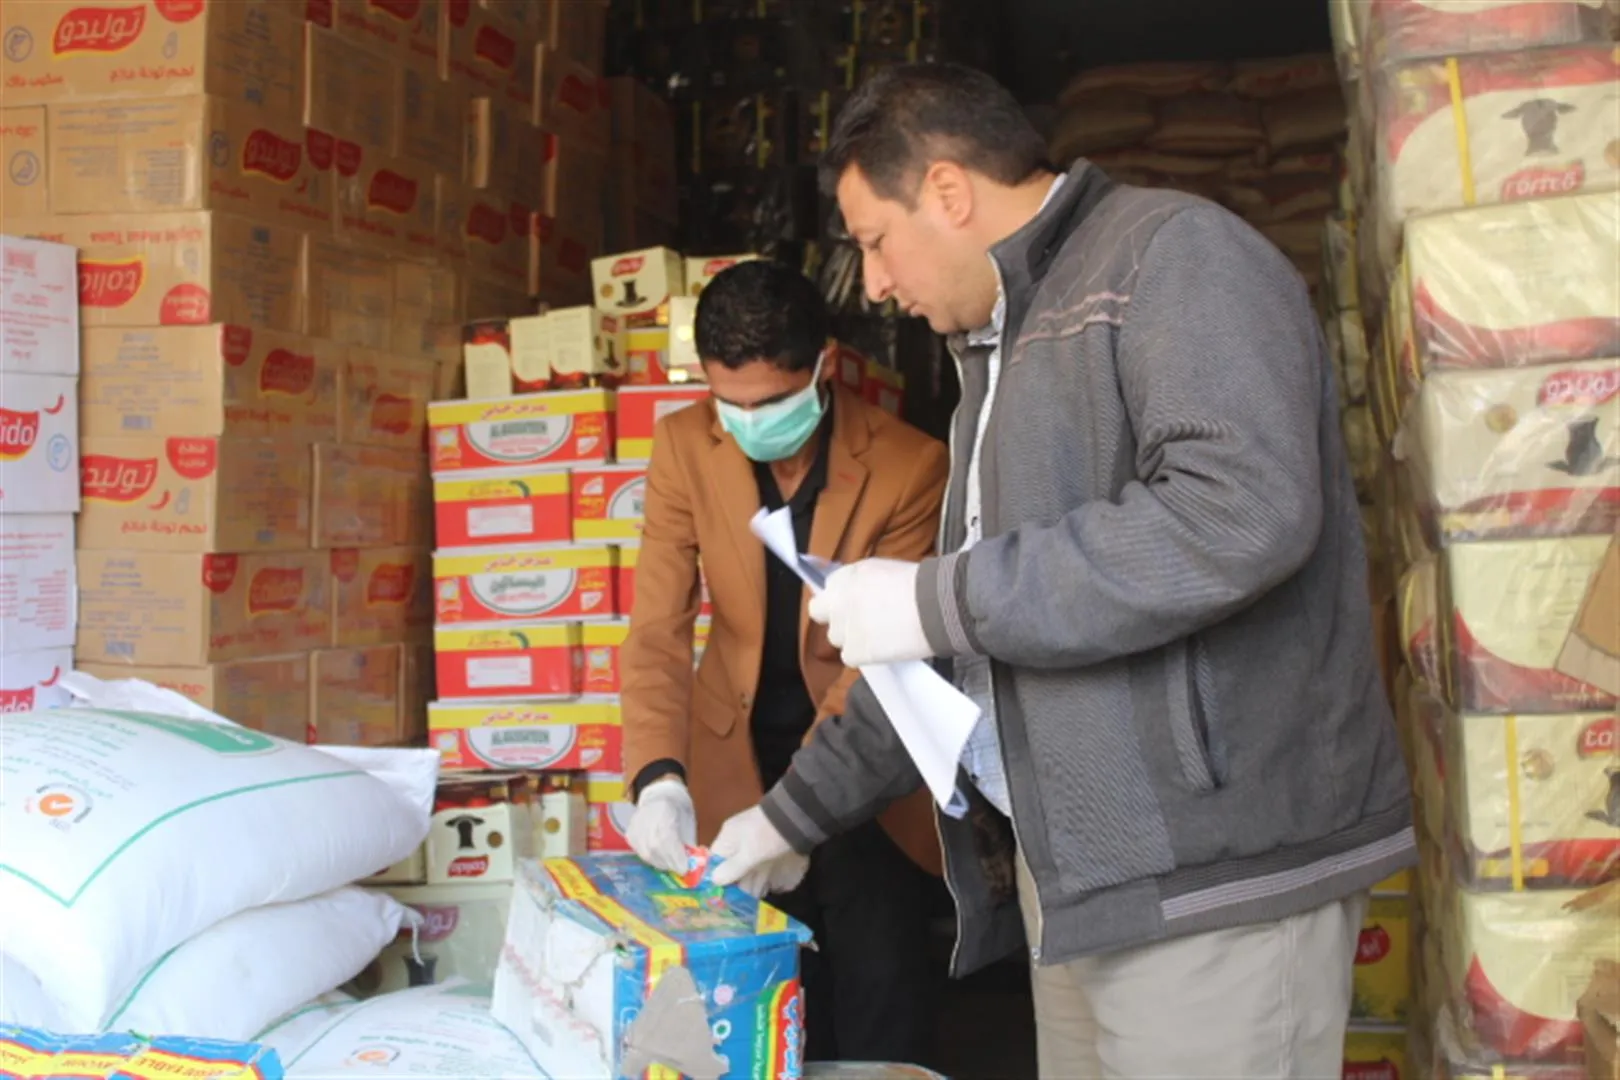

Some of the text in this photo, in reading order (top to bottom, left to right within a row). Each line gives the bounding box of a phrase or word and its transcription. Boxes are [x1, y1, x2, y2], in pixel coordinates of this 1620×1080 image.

[59, 11, 140, 48] توليدو
[0, 417, 35, 446] ido
[82, 464, 153, 493] توليد
